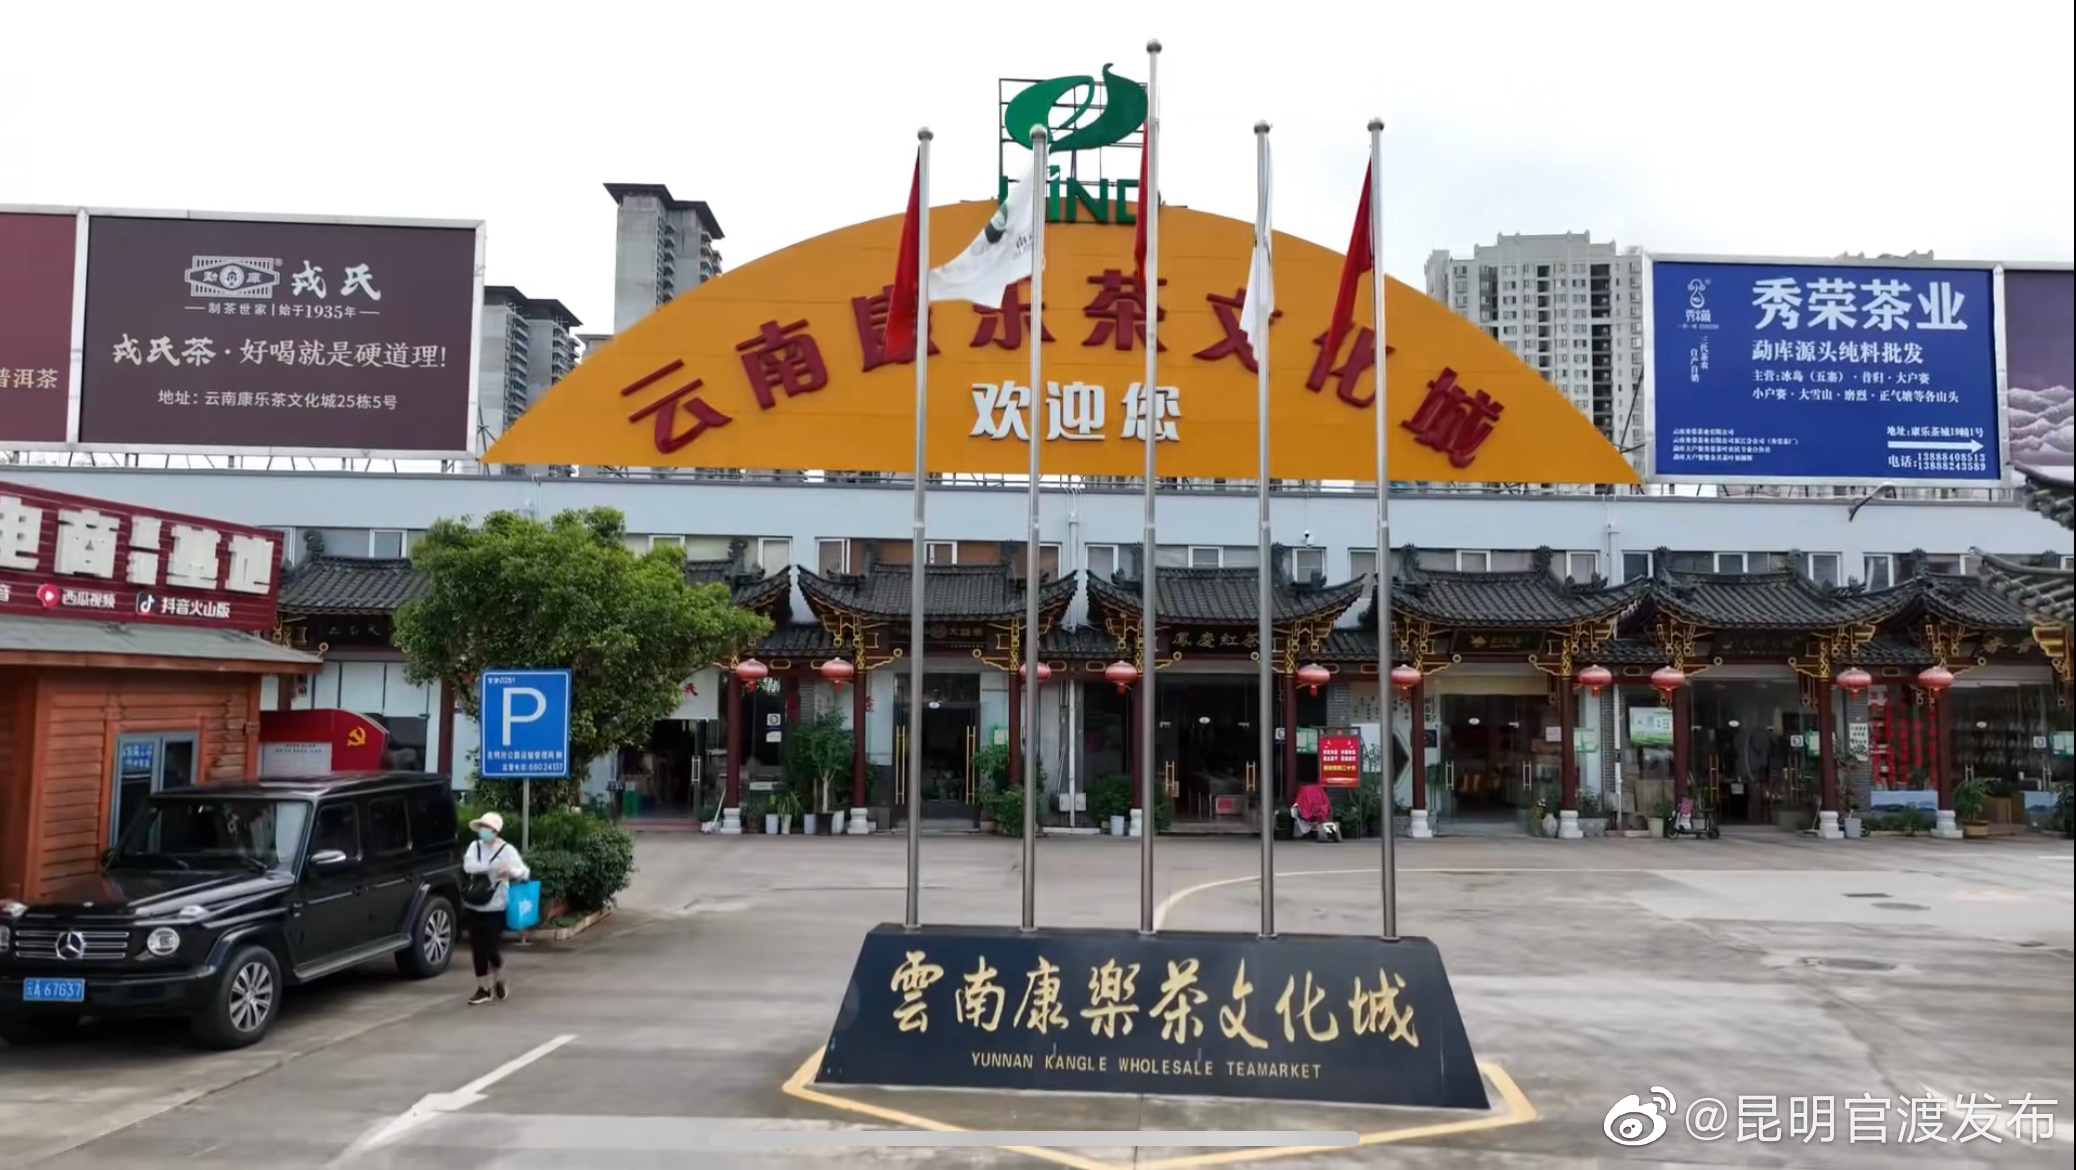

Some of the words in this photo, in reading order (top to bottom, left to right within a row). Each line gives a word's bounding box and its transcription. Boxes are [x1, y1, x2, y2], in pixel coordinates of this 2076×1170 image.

[208, 302, 267, 315] 制茶世家
[278, 304, 358, 319] 始于1935年
[1752, 277, 1969, 332] 秀荣茶业
[1751, 339, 1924, 365] 勐库源头纯料批发
[61, 590, 116, 609] 西瓜视频
[161, 597, 231, 618] 抖音火山版
[502, 687, 547, 747] P
[971, 1052, 1034, 1069] YUNNAN
[1044, 1054, 1108, 1073] KANGLE
[1118, 1056, 1214, 1077] WHOLESALE
[1226, 1061, 1322, 1080] TEAMARKET
